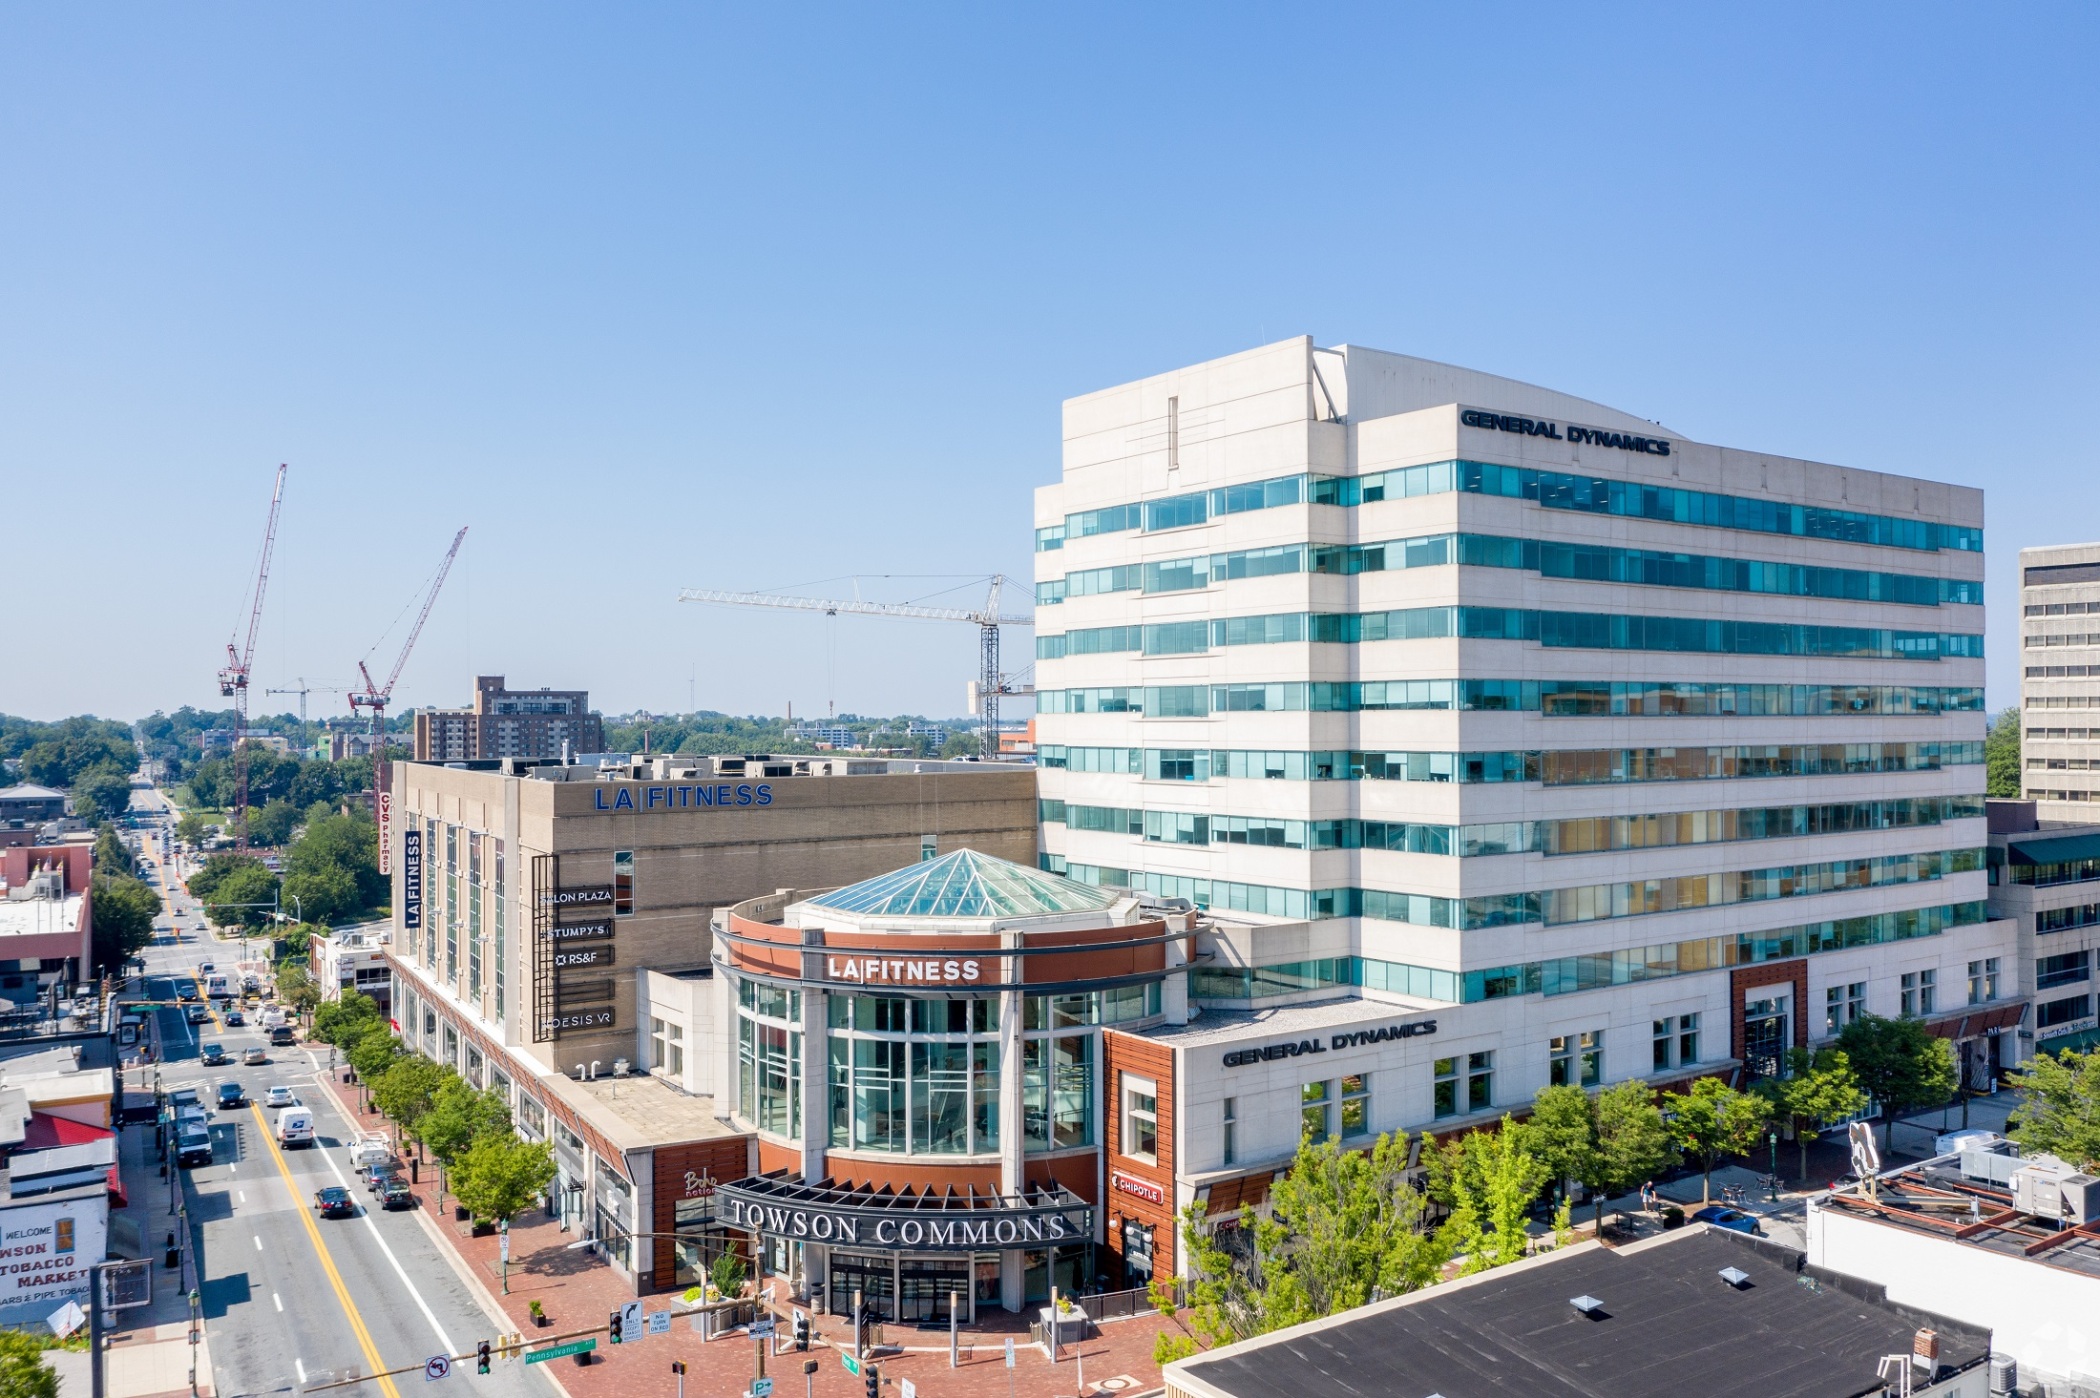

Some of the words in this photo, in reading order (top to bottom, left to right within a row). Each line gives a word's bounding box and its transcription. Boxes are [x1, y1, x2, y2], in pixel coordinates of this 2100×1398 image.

[1461, 409, 1563, 440] GENERAL
[1567, 425, 1671, 456] DYNAMICS
[381, 794, 390, 822] CVS
[381, 824, 390, 873] pharmacy
[540, 893, 576, 904] SALON
[578, 890, 612, 902] PLAZA
[547, 925, 605, 938] STUMPY'S
[569, 952, 597, 965] RS&F
[541, 1014, 593, 1029] NOESIS
[597, 1012, 610, 1023] VR
[1222, 1038, 1327, 1068] GENERAL
[1331, 1019, 1437, 1051] DYNAMICS
[684, 1167, 718, 1190] Boho
[1120, 1179, 1158, 1201] CHIPOTLE
[730, 1199, 860, 1242] TOWSON
[875, 1214, 1065, 1245] COMMONS
[6, 1226, 53, 1240] WELCOME
[0, 1256, 75, 1276] TOBACCO
[18, 1269, 88, 1288] MARKET
[34, 1290, 56, 1300] PIPE
[526, 1345, 578, 1363] Pennsylvania
[755, 1382, 765, 1395] P
